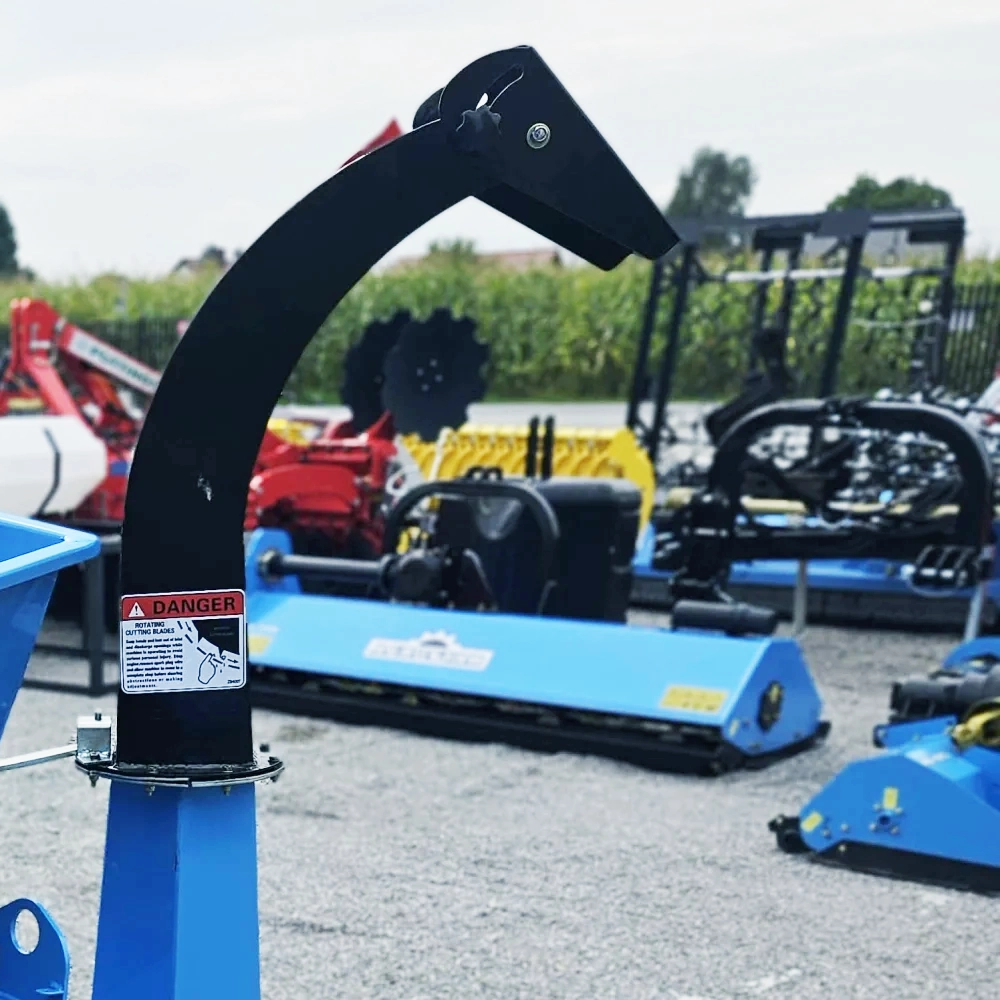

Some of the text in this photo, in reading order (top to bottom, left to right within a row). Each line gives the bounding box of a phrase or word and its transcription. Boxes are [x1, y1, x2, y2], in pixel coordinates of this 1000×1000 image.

[153, 596, 236, 615] DANGER
[134, 621, 166, 629] ROTATING
[152, 627, 175, 635] BLADES
